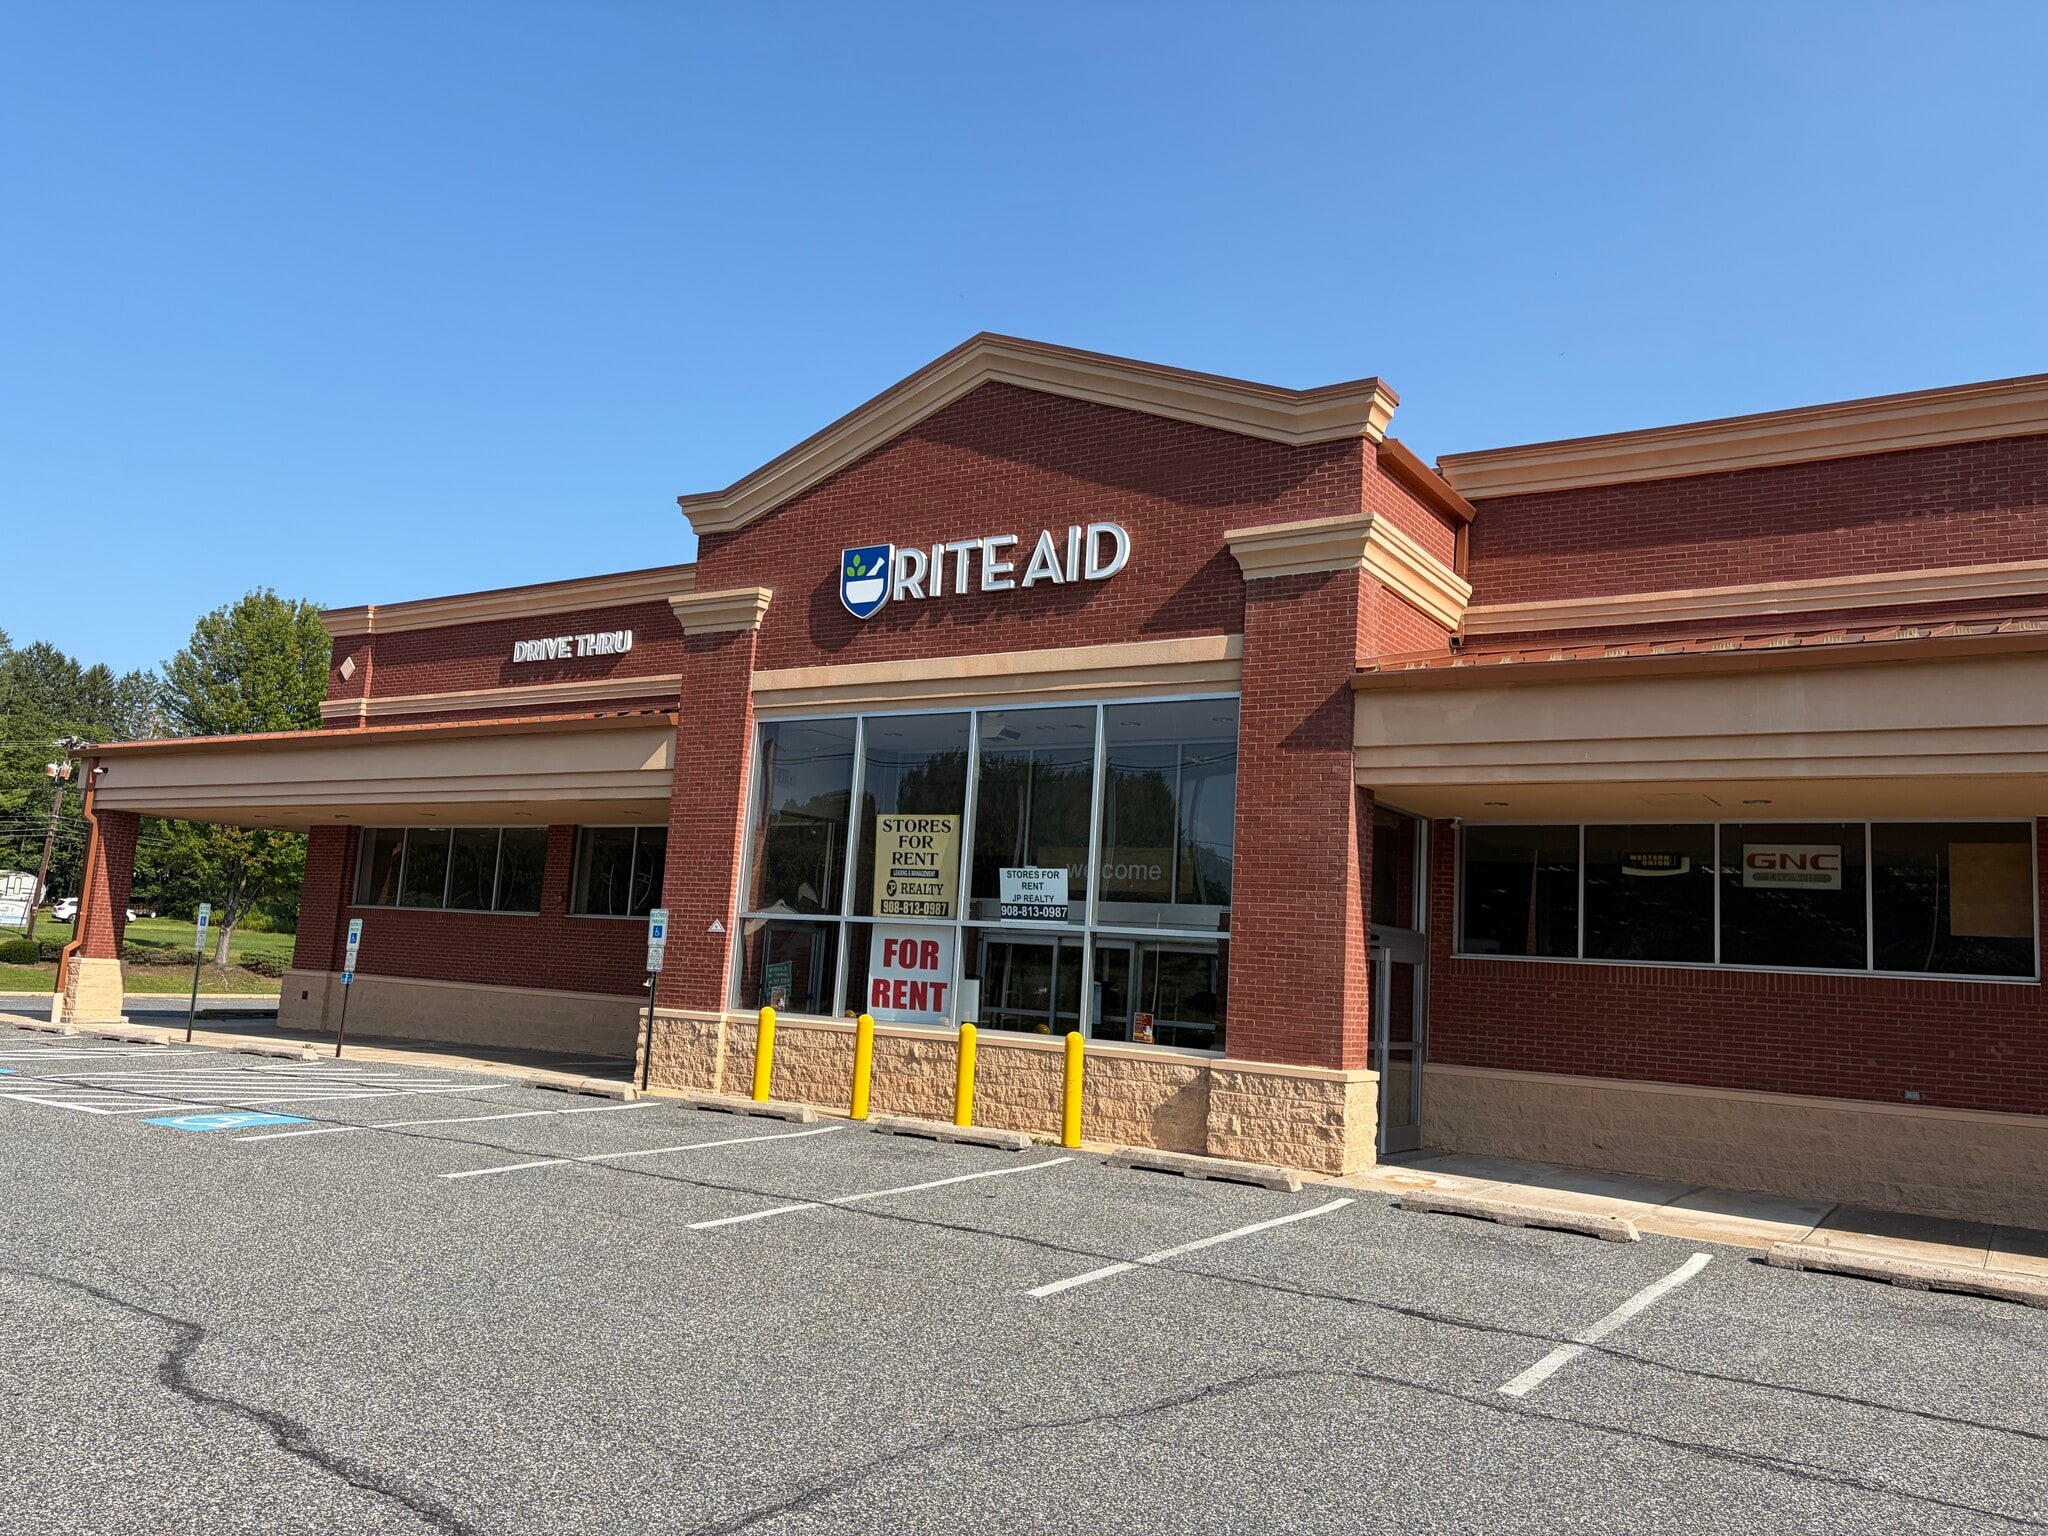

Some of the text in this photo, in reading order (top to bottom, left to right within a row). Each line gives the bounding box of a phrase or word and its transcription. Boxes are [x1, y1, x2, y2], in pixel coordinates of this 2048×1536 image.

[893, 522, 1131, 600] RITE AID
[513, 630, 633, 663] DRIVE THRU
[882, 819, 952, 833] STORES
[898, 835, 934, 849] FOR
[892, 851, 939, 866] RENT
[1746, 853, 1838, 870] GNC
[1006, 870, 1060, 879] STORES FOR
[1067, 863, 1162, 881] wcome
[900, 883, 944, 896] REALTY
[1021, 882, 1045, 890] RENT
[1012, 894, 1055, 903] JP REALTY
[882, 900, 947, 916] 908-813-0987
[1000, 905, 1068, 918] 908-813-0987
[883, 938, 939, 970] FOR
[871, 978, 948, 1012] RENT
